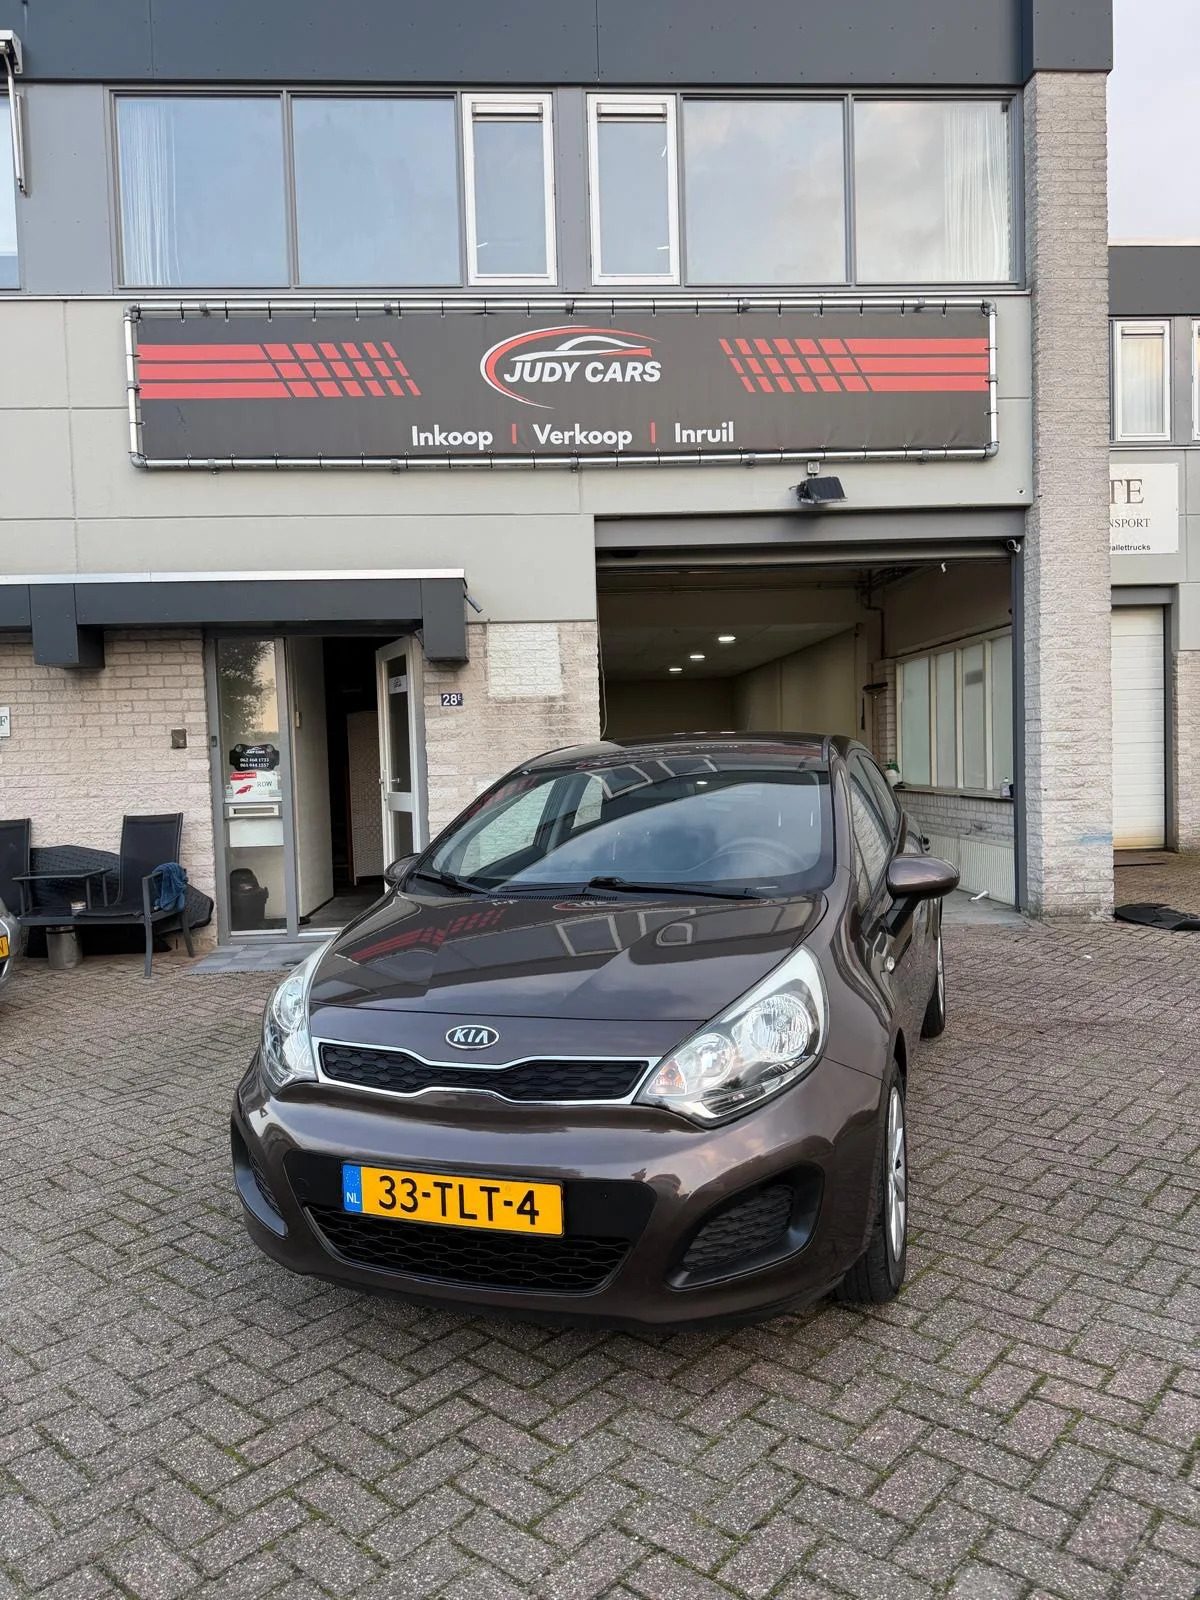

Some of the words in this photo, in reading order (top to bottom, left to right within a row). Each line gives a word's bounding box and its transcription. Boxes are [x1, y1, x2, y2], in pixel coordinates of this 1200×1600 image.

[503, 361, 580, 383] JUDY
[585, 361, 662, 383] CARS
[411, 424, 493, 450] Inkoop
[533, 423, 633, 450] Verkoop
[674, 421, 734, 444] Inruil
[1109, 543, 1151, 551] allettrucks
[453, 1028, 488, 1044] KIA
[346, 1192, 360, 1204] NL
[378, 1175, 540, 1225] 33-TLT-4
